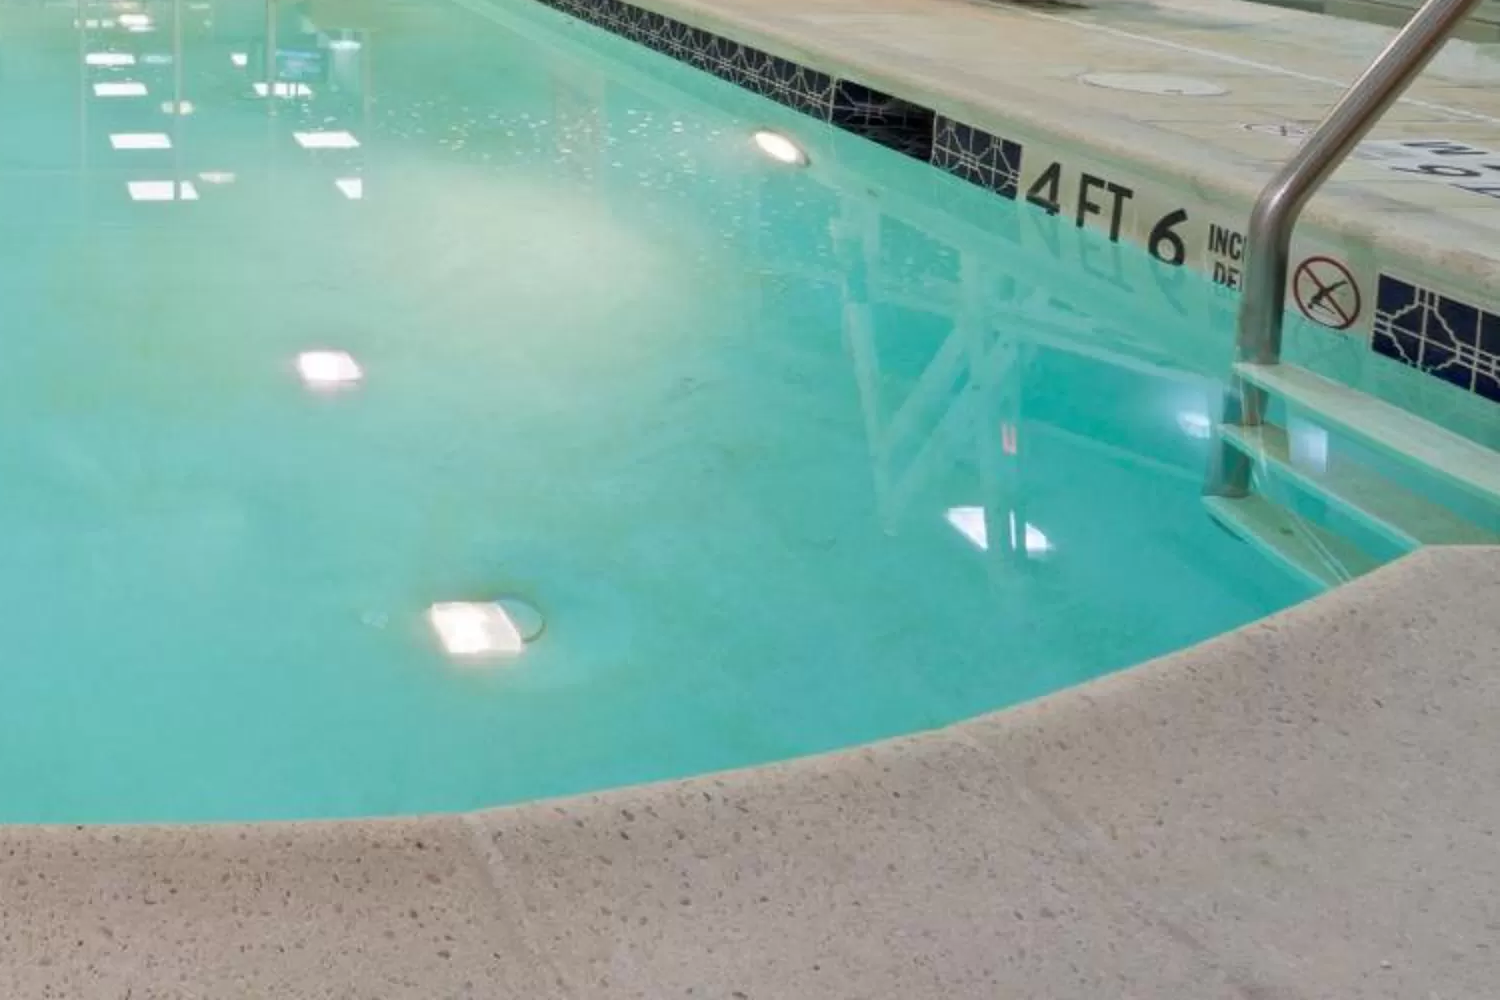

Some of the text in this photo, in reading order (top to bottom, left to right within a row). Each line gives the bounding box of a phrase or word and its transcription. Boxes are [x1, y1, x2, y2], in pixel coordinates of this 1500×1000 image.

[1026, 161, 1247, 267] 4 FT 6 INC
[1212, 261, 1244, 293] DE
